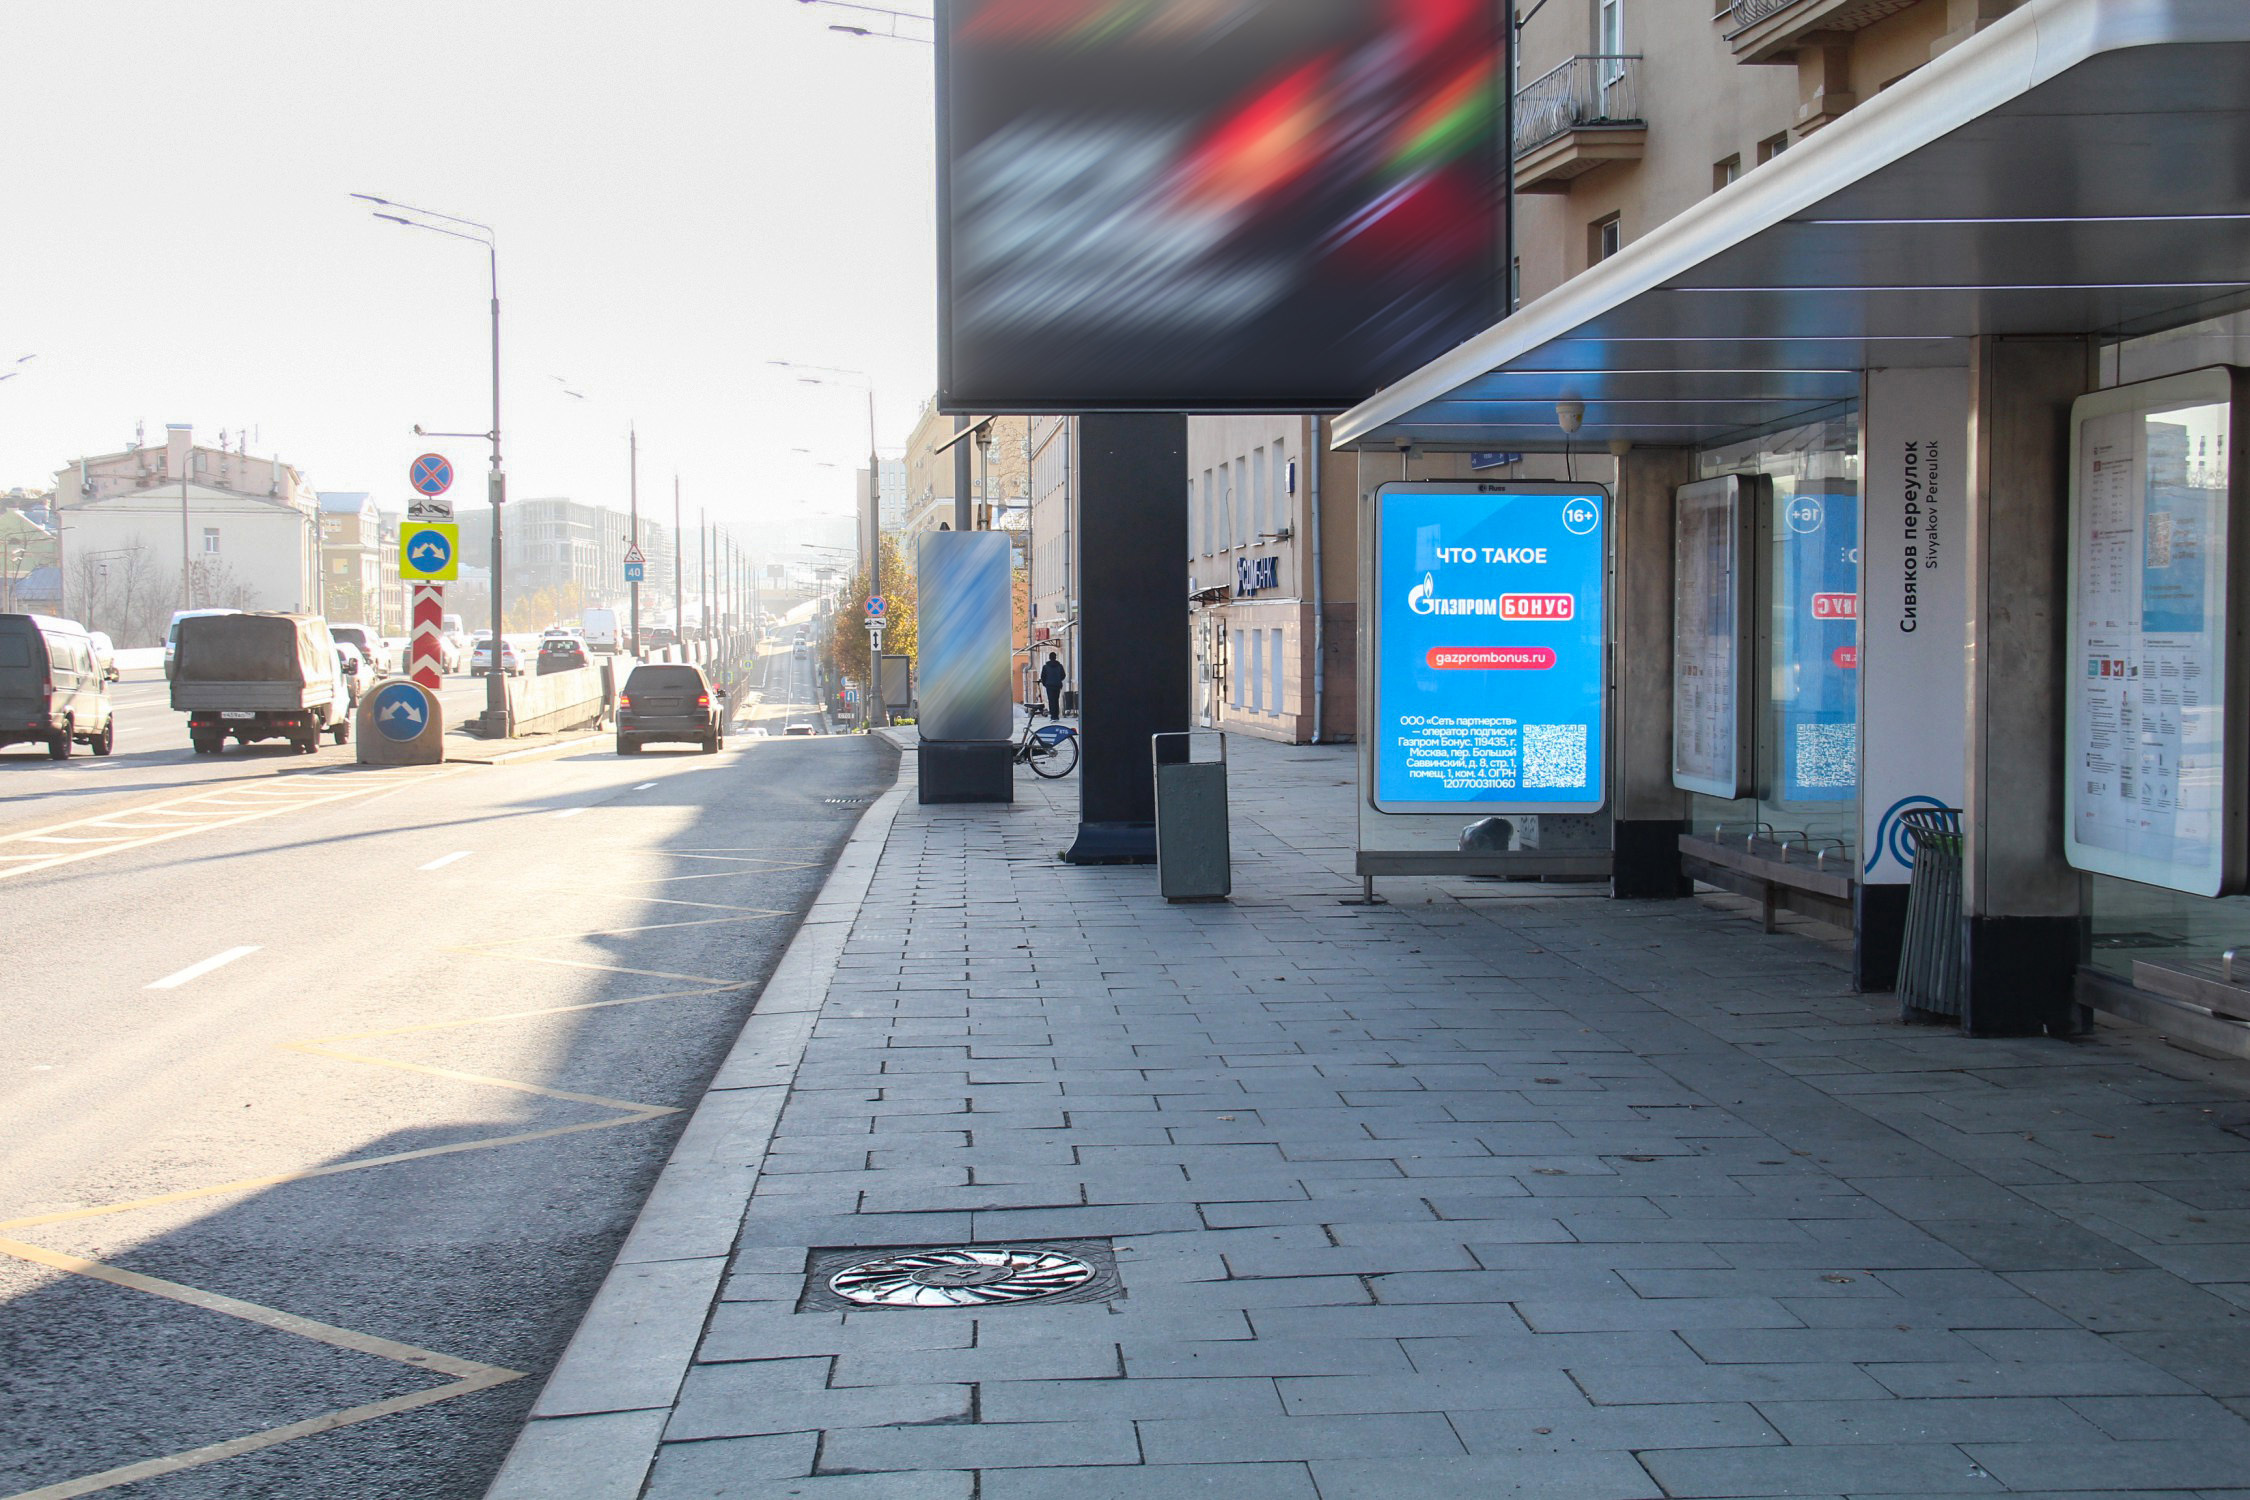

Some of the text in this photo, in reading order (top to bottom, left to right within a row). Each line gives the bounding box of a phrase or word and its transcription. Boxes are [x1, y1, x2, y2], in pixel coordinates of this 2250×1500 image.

[1925, 440, 1940, 569] Sivyakov Pereulok
[1567, 508, 1593, 523] 16+
[1899, 441, 1922, 633] Сивяков переулок
[1436, 547, 1548, 564] ЧТО ТАКОЕ
[628, 568, 641, 577] 40
[1434, 598, 1569, 616] ГАЗПРОМ БОНУС
[1435, 651, 1546, 666] gazprombonus.ru
[1400, 716, 1517, 728] ООО «Сеть партнерств»
[1422, 728, 1468, 737] оператор
[1470, 728, 1517, 737] подписки
[1398, 737, 1517, 748] Газпром Бонус. 119435, г.
[1410, 748, 1517, 759] Москва, пер. Большой
[1406, 758, 1517, 769] Саввинский, д. 8, стр. 1,
[1447, 769, 1454, 779] 1,
[1455, 770, 1477, 779] ком.
[1478, 769, 1487, 778] 4.
[1488, 769, 1517, 778] ОГРН
[1443, 779, 1515, 788] 1207700311060
